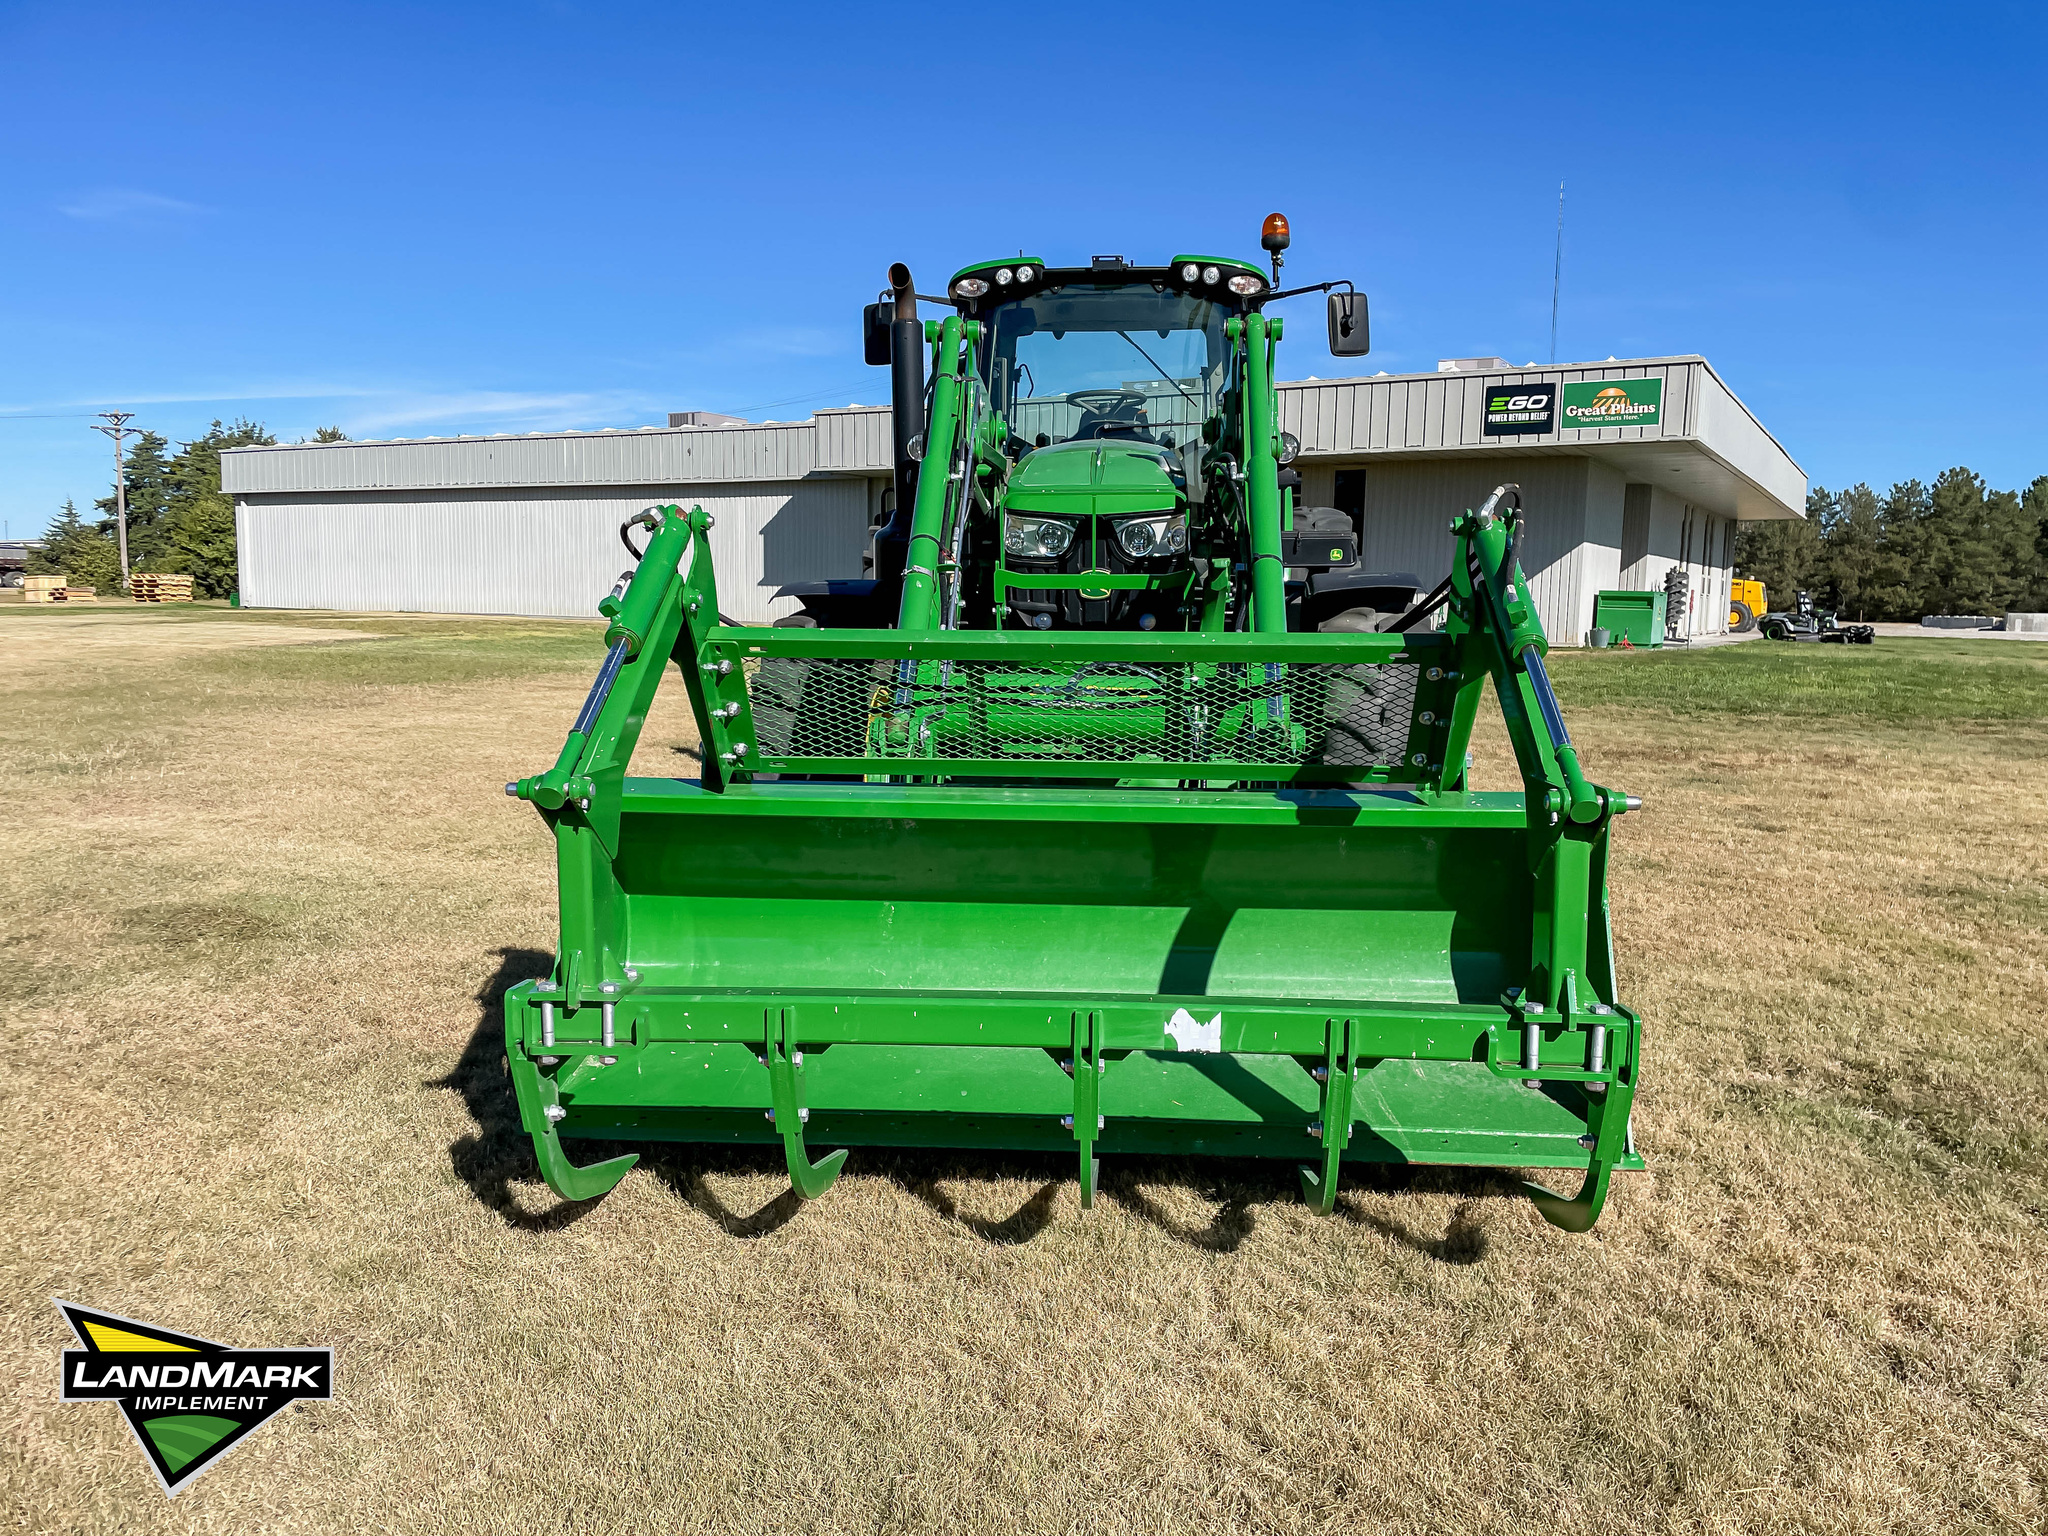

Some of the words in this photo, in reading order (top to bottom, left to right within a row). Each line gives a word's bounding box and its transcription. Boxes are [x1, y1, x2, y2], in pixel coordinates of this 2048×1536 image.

[1489, 395, 1549, 410] EGO
[1566, 405, 1608, 417] Great
[1611, 402, 1656, 415] Plains
[1488, 413, 1508, 423] POWER
[1508, 412, 1530, 422] BEYOND
[1530, 411, 1549, 421] BELIEF
